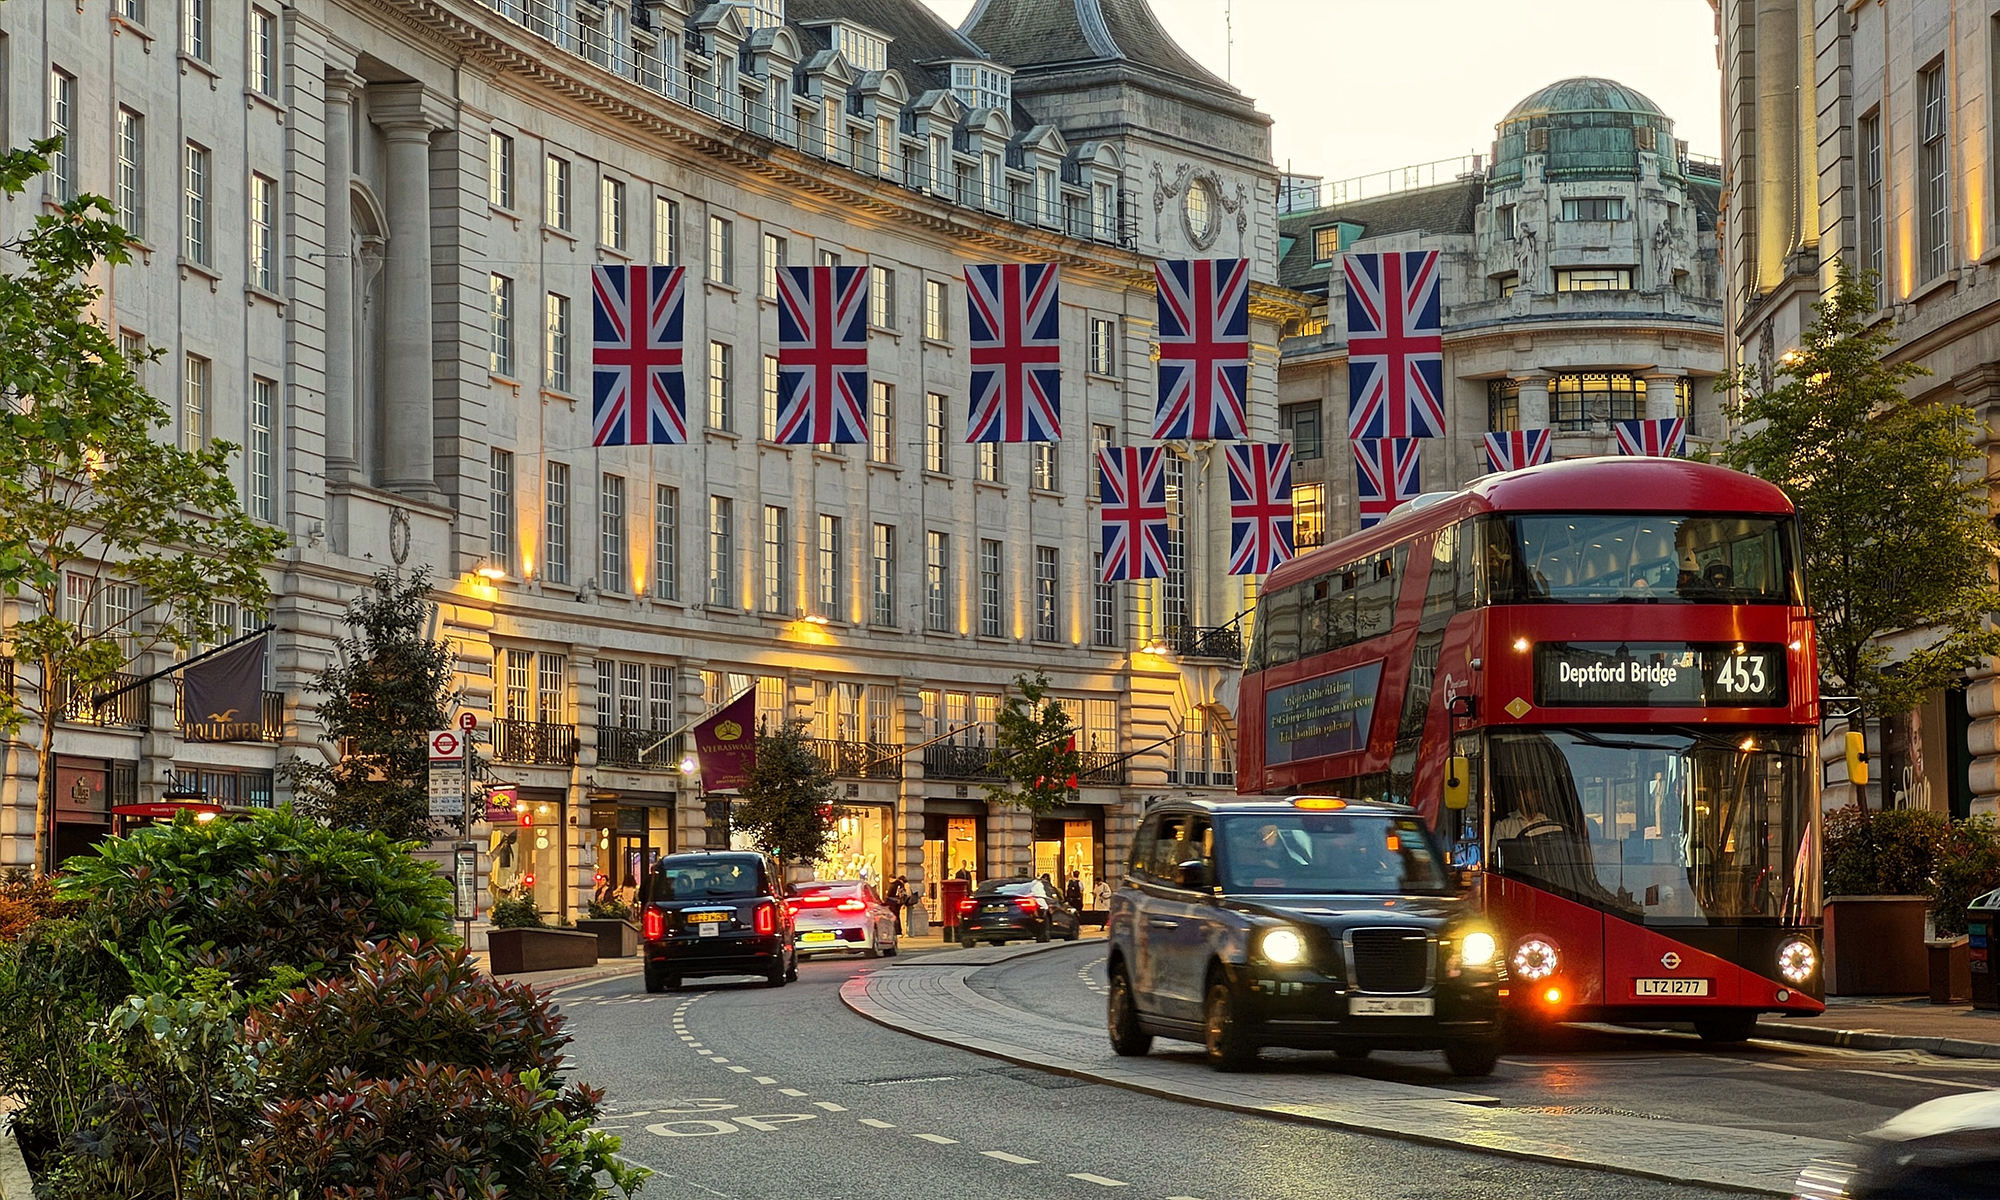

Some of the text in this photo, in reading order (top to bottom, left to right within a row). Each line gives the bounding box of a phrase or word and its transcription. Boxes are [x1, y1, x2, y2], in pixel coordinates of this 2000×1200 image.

[1560, 661, 1677, 688] Deptford Bridge
[1716, 656, 1765, 693] 453
[185, 722, 260, 740] HOLLISTER
[463, 714, 472, 728] E
